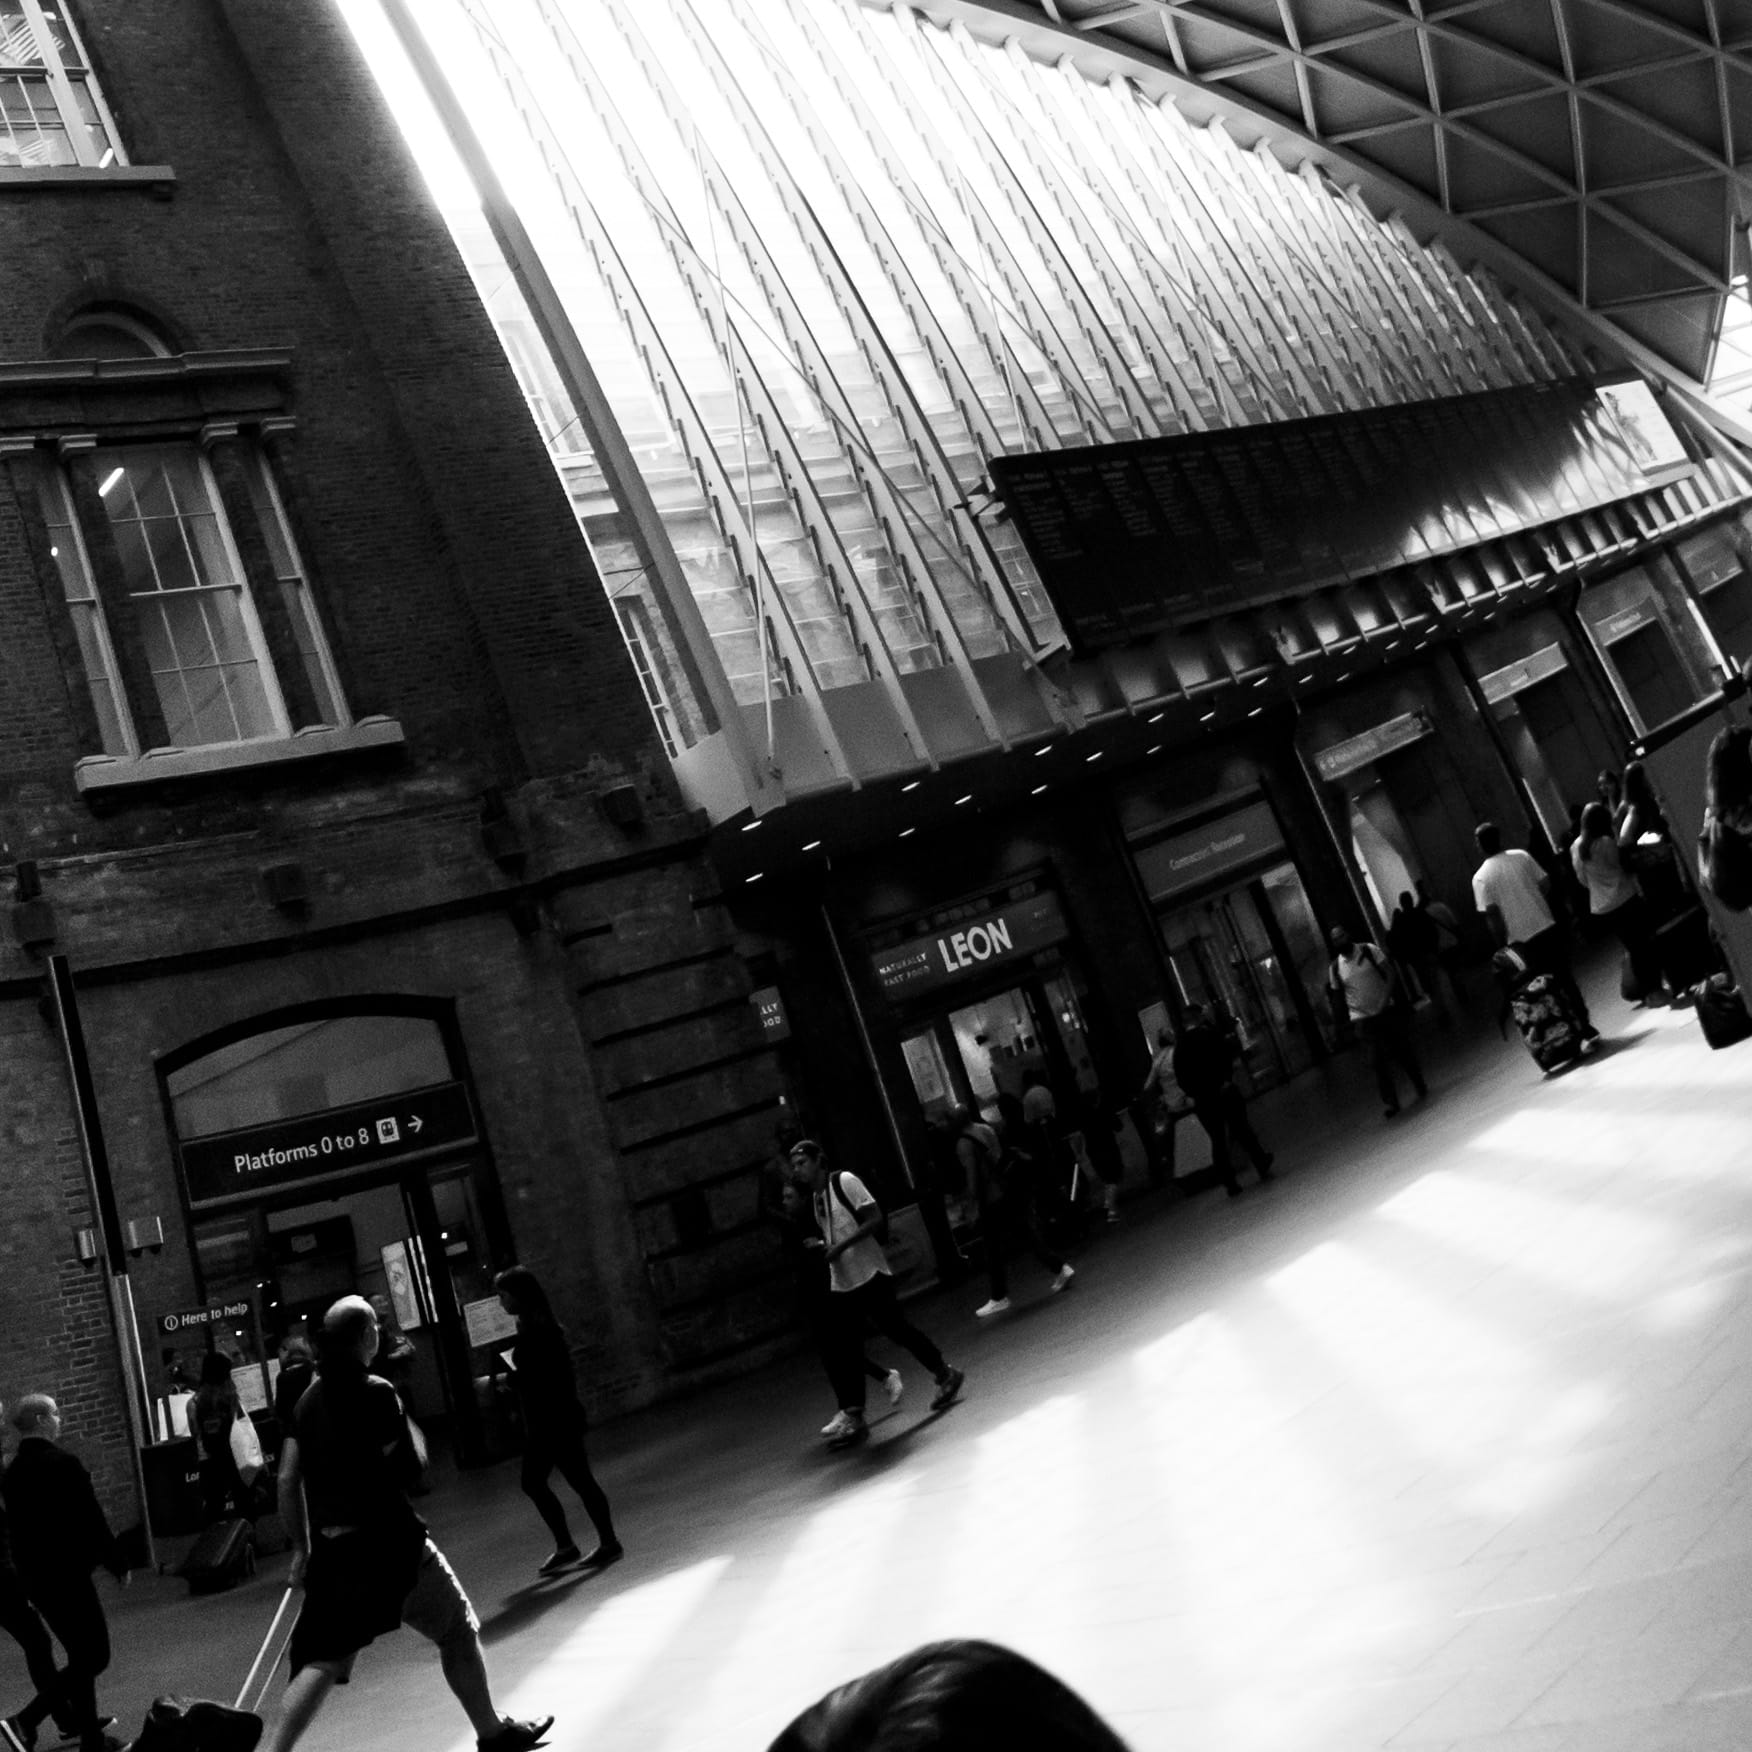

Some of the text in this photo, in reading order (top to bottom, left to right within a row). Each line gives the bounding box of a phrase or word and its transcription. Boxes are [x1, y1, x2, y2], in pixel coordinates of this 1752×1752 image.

[937, 917, 1013, 973] LEON
[233, 1126, 370, 1174] Platforms 0 to 8
[181, 1302, 248, 1326] Here to help
